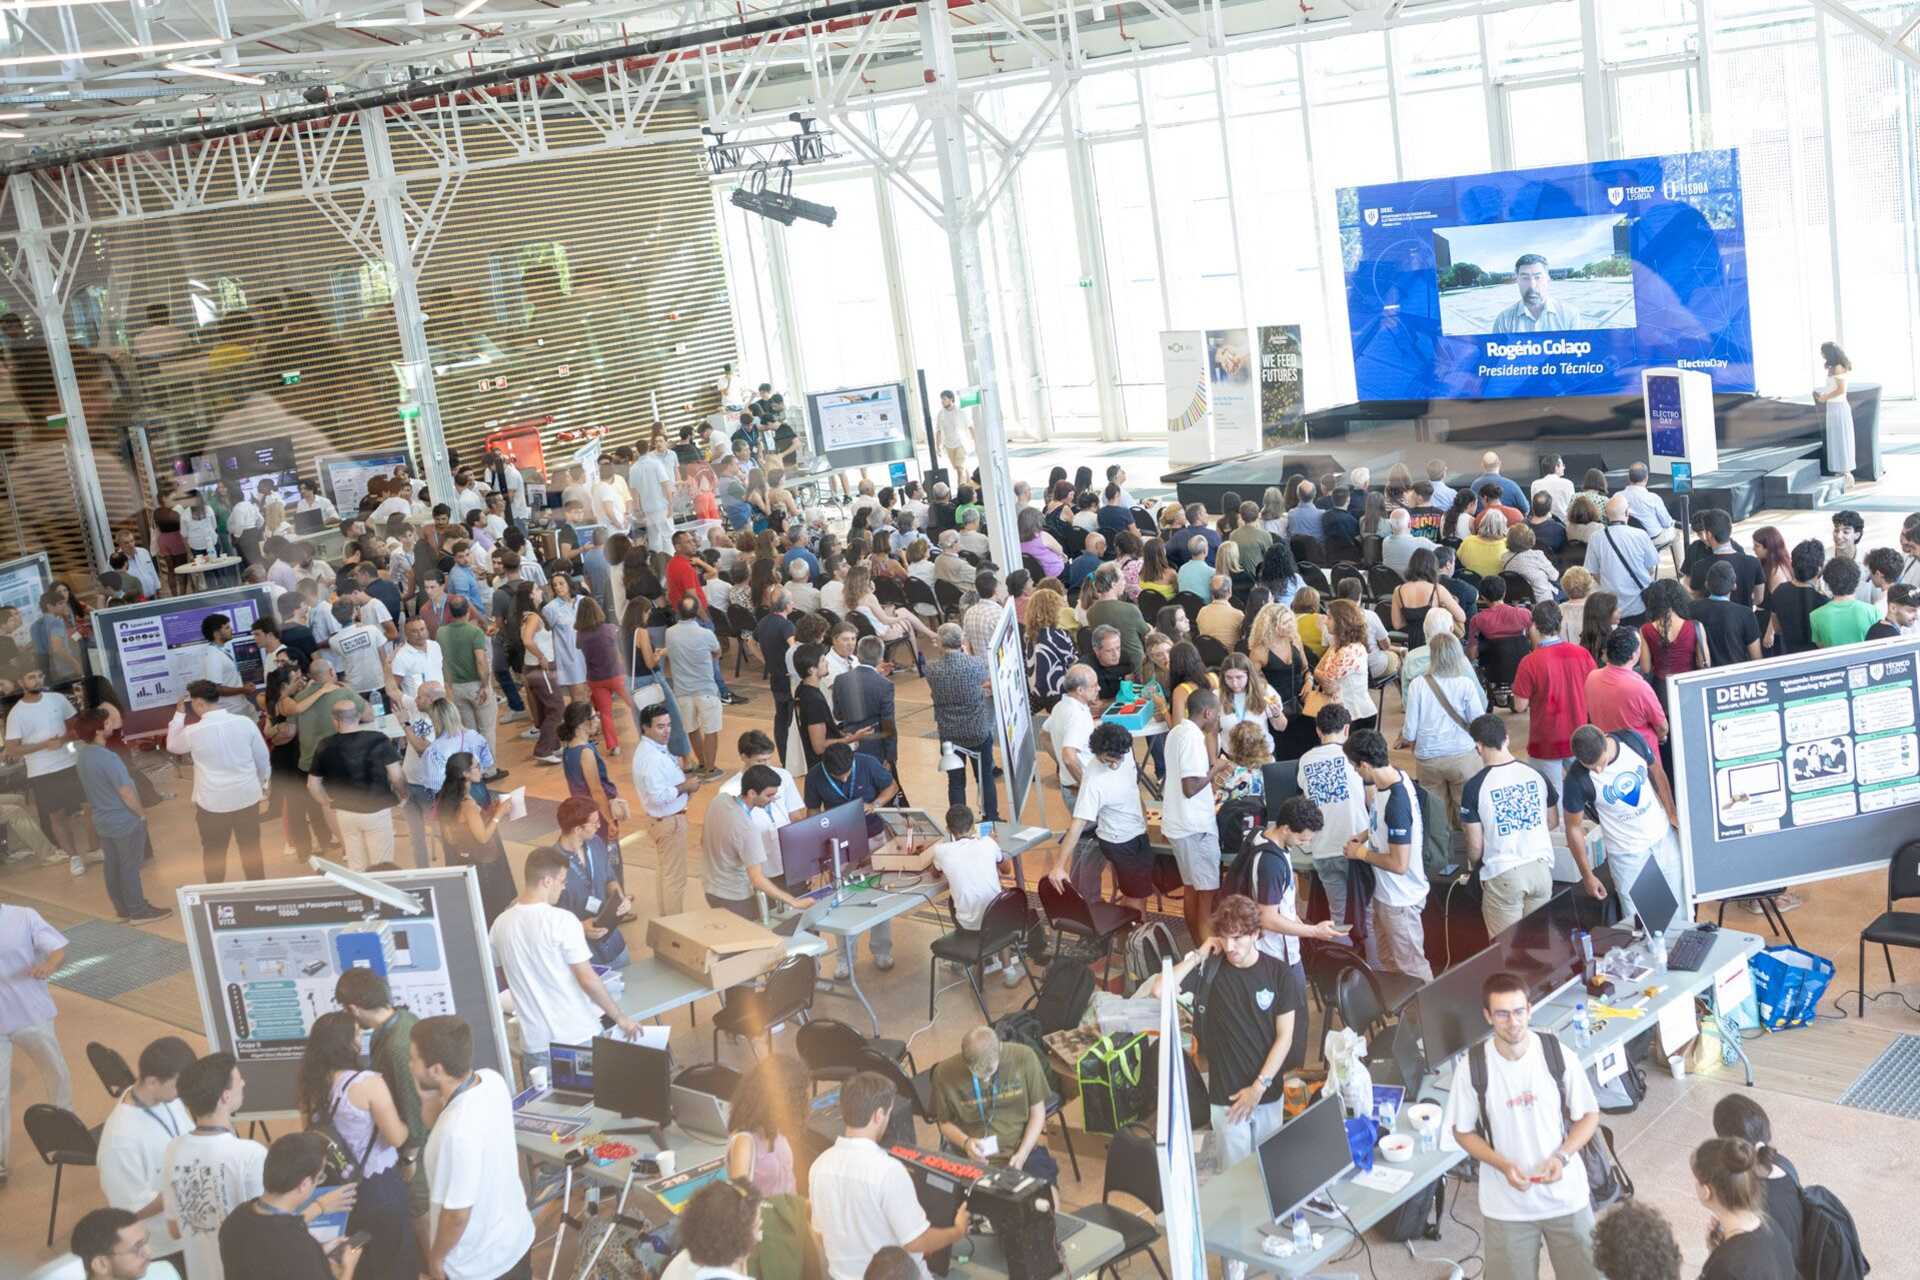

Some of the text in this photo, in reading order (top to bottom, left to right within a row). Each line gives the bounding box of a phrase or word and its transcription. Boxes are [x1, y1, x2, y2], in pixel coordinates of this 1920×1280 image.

[1625, 186, 1655, 196] TÉCNICO
[1680, 181, 1709, 196] LISBOA
[1627, 193, 1652, 201] LISBOA
[1486, 338, 1591, 360] Rogério Colaço
[1261, 353, 1297, 368] WE FEED
[1677, 358, 1729, 369] ElectroDay
[1261, 367, 1298, 382] FUTURES
[1478, 361, 1604, 377] Presidente do Técnico
[1652, 409, 1680, 418] ELECTRO
[1660, 417, 1673, 425] DAY
[1780, 670, 1847, 688] Dynamic Emergency
[1783, 678, 1843, 694] Monitoring System
[1716, 681, 1768, 704] DEMS
